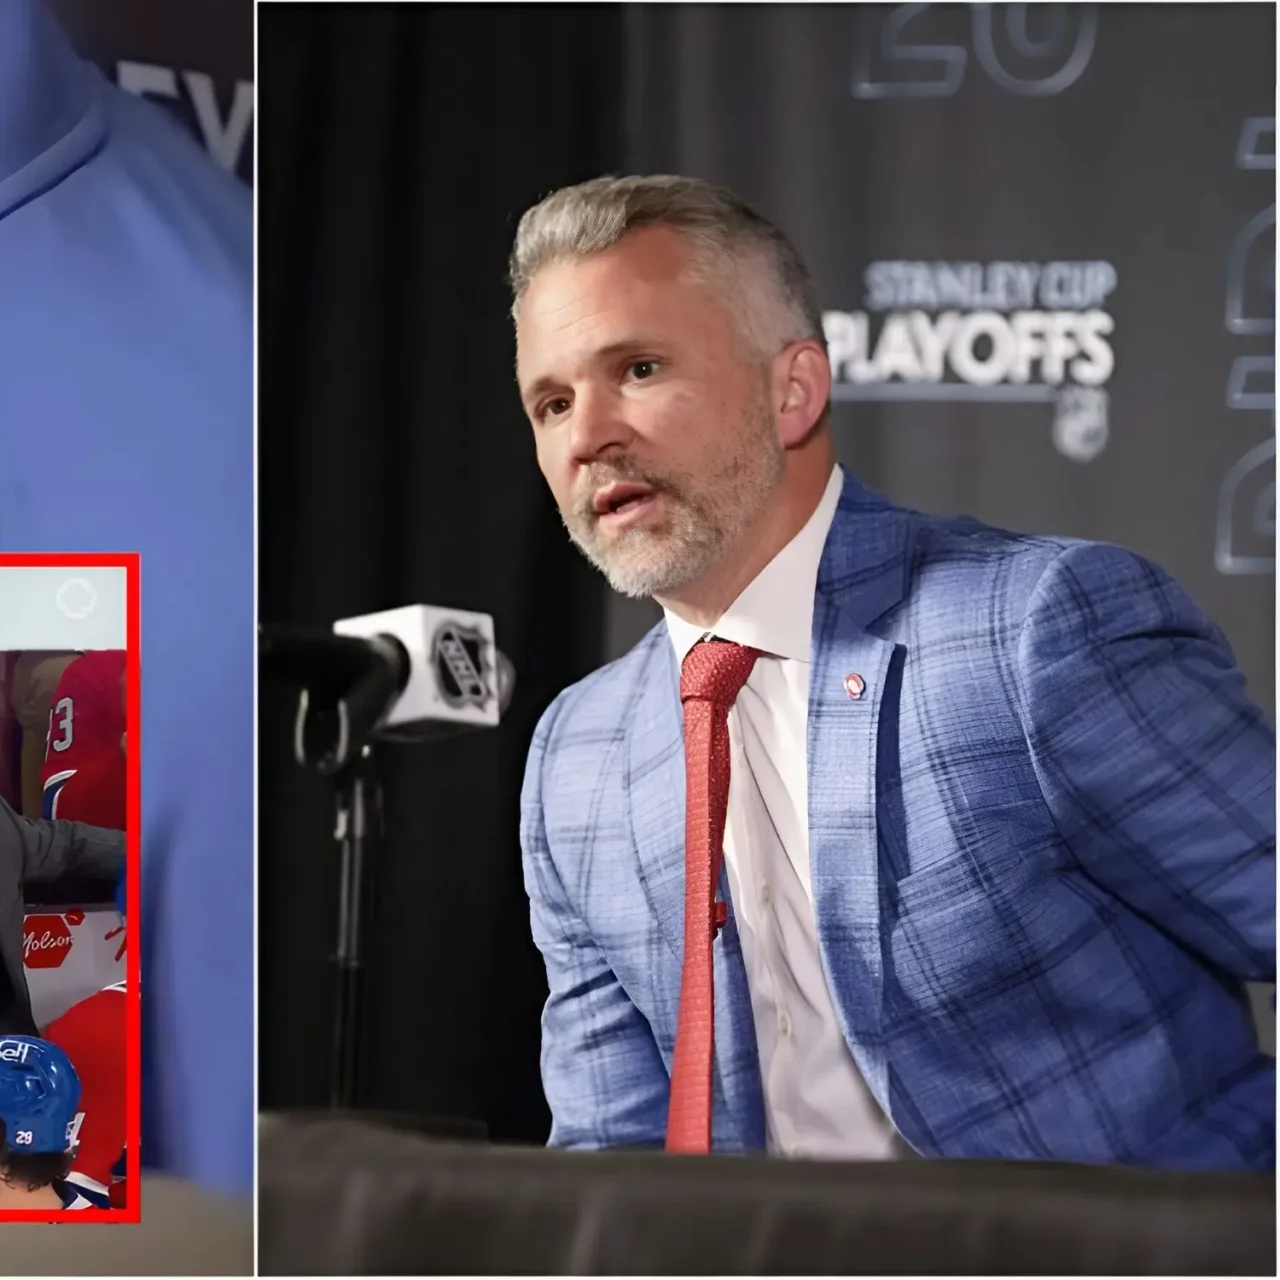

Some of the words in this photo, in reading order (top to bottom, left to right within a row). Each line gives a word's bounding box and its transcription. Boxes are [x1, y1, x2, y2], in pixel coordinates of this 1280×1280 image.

[865, 260, 1039, 309] STANLEY
[1039, 260, 1118, 309] CUP
[823, 309, 1115, 386] PLAYOFFS
